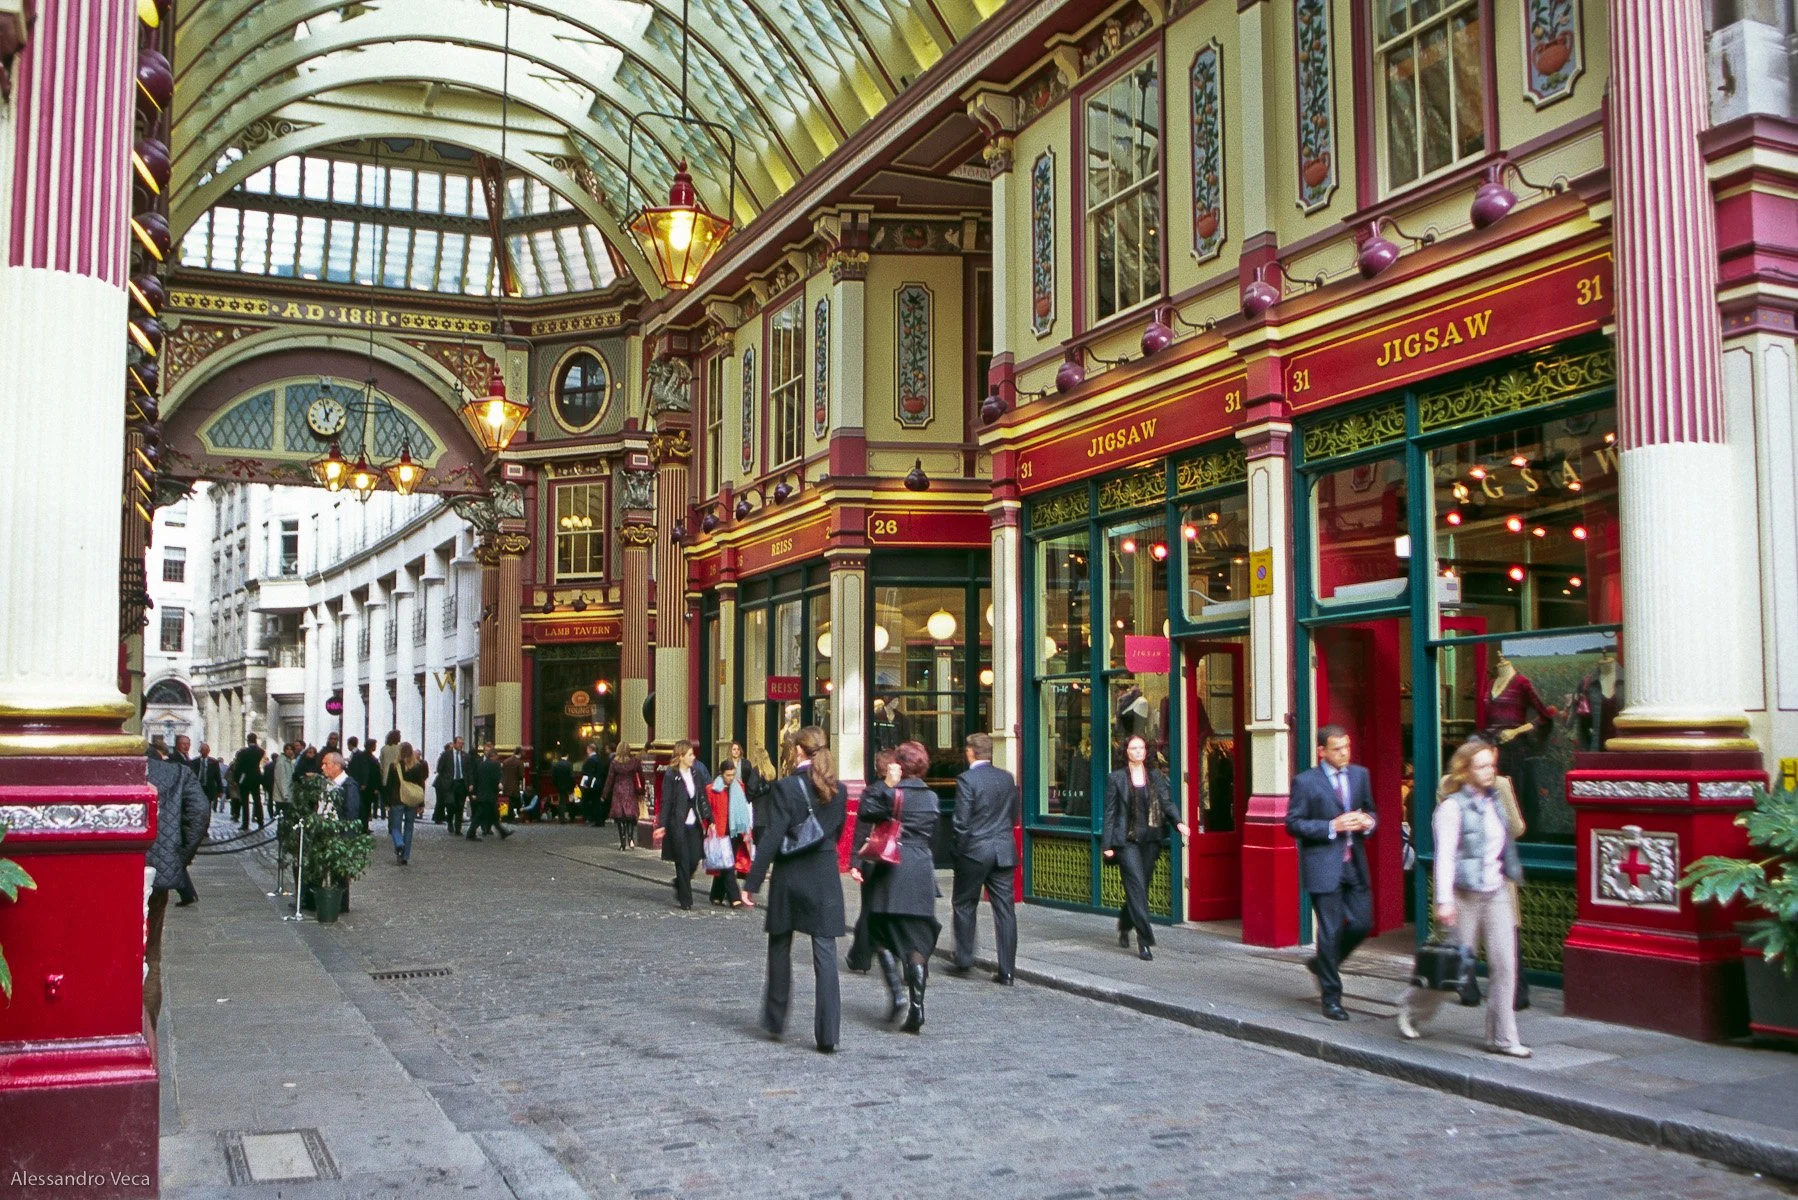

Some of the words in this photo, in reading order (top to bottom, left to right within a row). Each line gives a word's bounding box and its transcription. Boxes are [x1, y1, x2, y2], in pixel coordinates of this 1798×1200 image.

[338, 306, 389, 326] 1881
[1292, 368, 1311, 393] 31
[1375, 309, 1493, 367] JIGSAW
[1576, 274, 1604, 306] 31
[1020, 460, 1033, 479] 31
[1087, 418, 1158, 458] JIGSAW
[1224, 389, 1243, 413] 31
[874, 519, 898, 535] 26
[771, 537, 793, 557] REISS
[545, 627, 570, 637] LAMB
[573, 625, 611, 635] TAVERN
[771, 682, 799, 694] REISS
